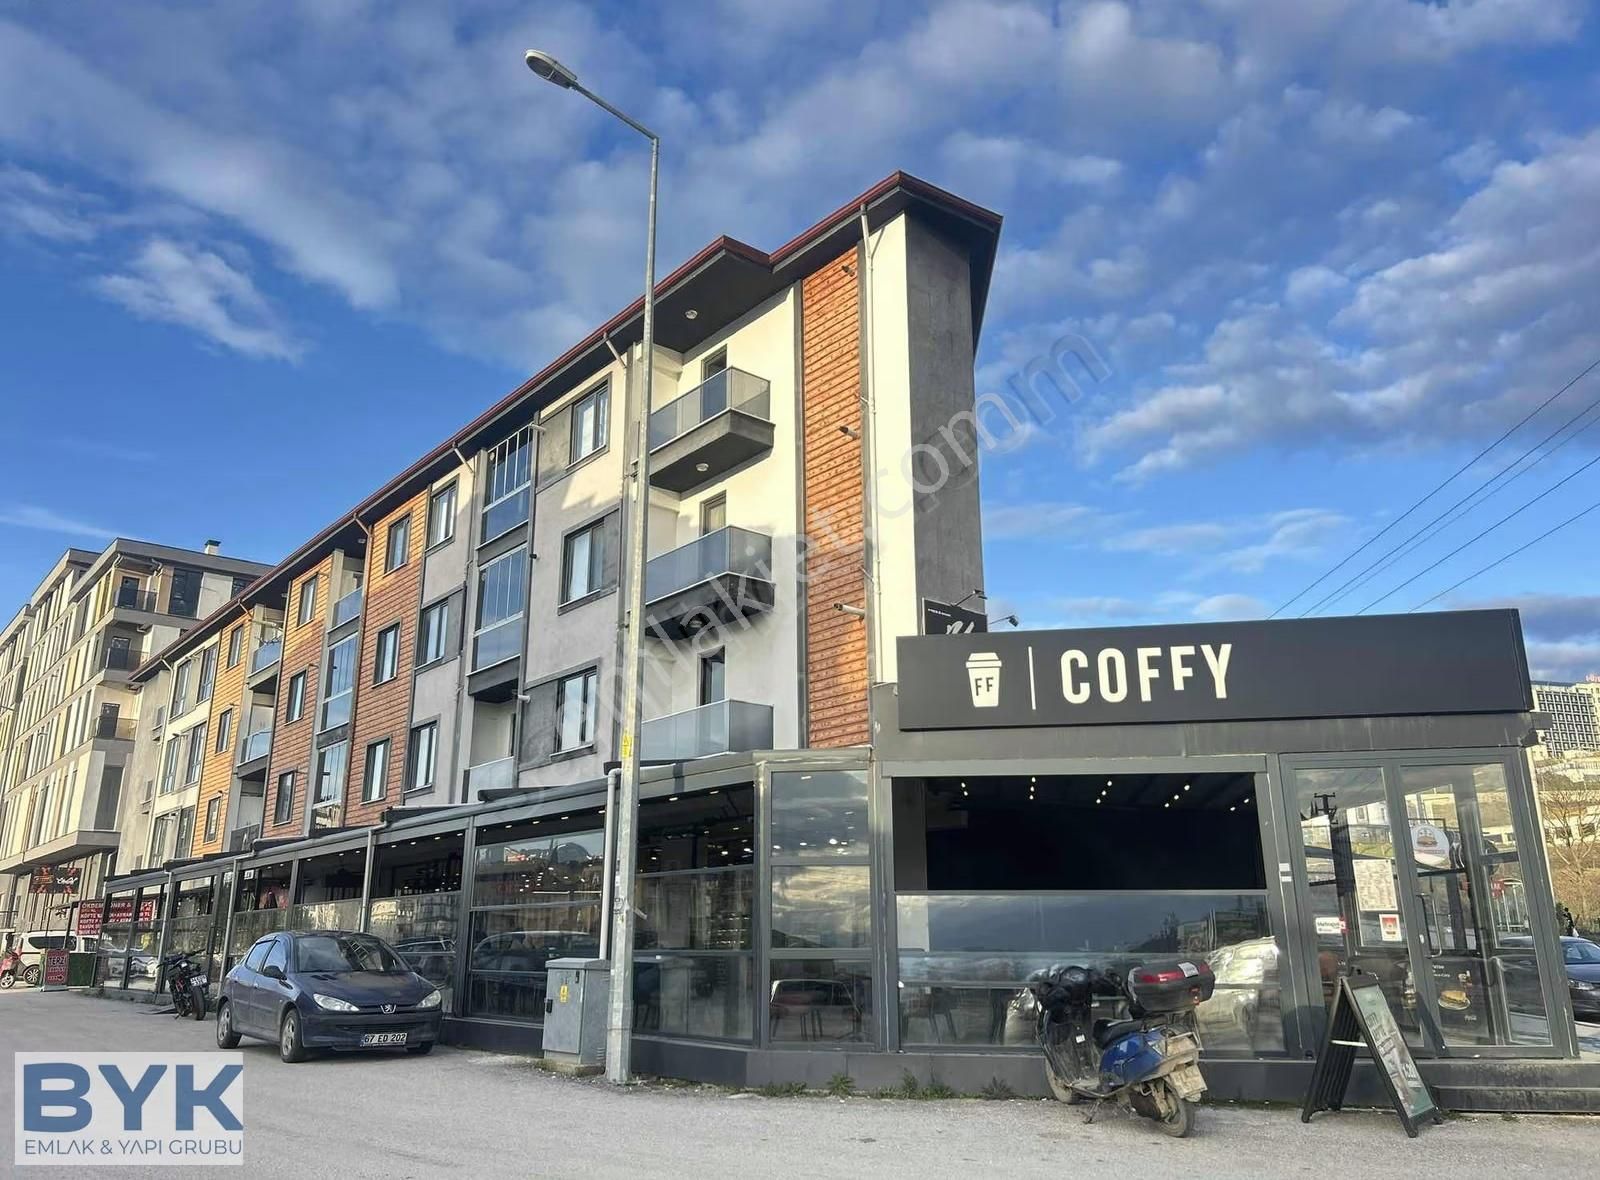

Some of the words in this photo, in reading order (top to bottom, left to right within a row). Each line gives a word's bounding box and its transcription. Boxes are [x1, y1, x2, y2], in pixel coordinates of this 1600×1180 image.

[1060, 643, 1232, 705] COFFY
[974, 676, 994, 696] FF
[364, 1034, 375, 1043] 67
[377, 1034, 388, 1043] ED
[390, 1033, 406, 1042] 202
